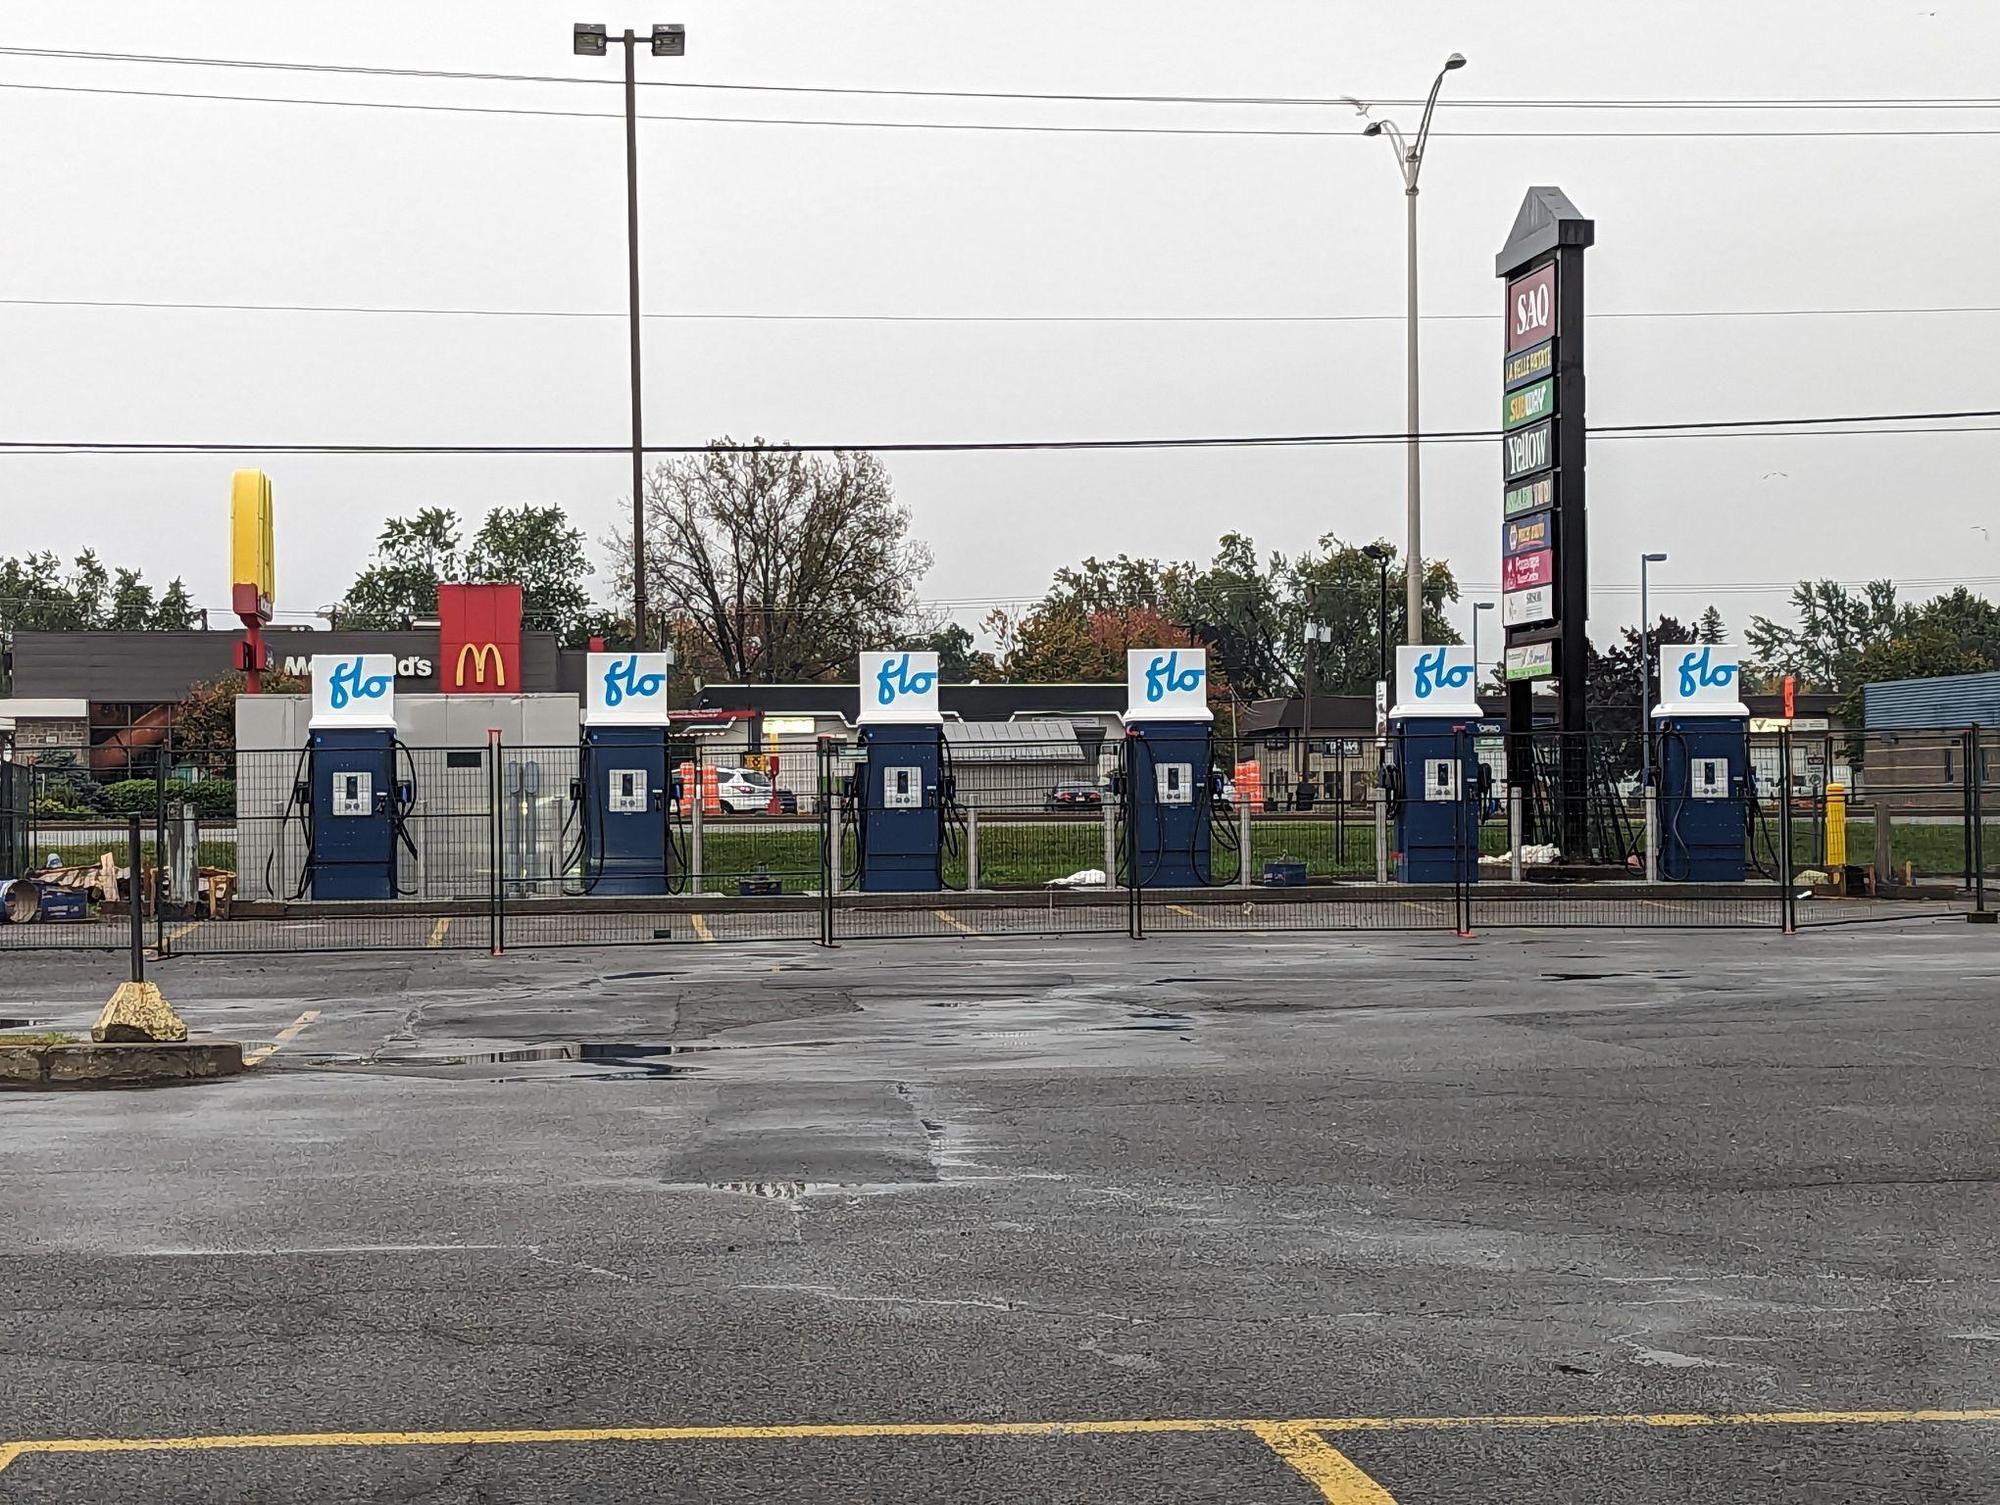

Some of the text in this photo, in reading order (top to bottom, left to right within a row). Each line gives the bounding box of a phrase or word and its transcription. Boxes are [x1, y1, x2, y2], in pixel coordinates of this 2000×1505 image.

[1517, 283, 1549, 335] SAQ
[1508, 429, 1547, 475] Yellow
[329, 656, 392, 709] flo
[604, 655, 665, 707] flo
[877, 654, 937, 705] flo
[1145, 651, 1205, 702] flo
[1414, 647, 1474, 698] flo
[1679, 647, 1739, 697] flo
